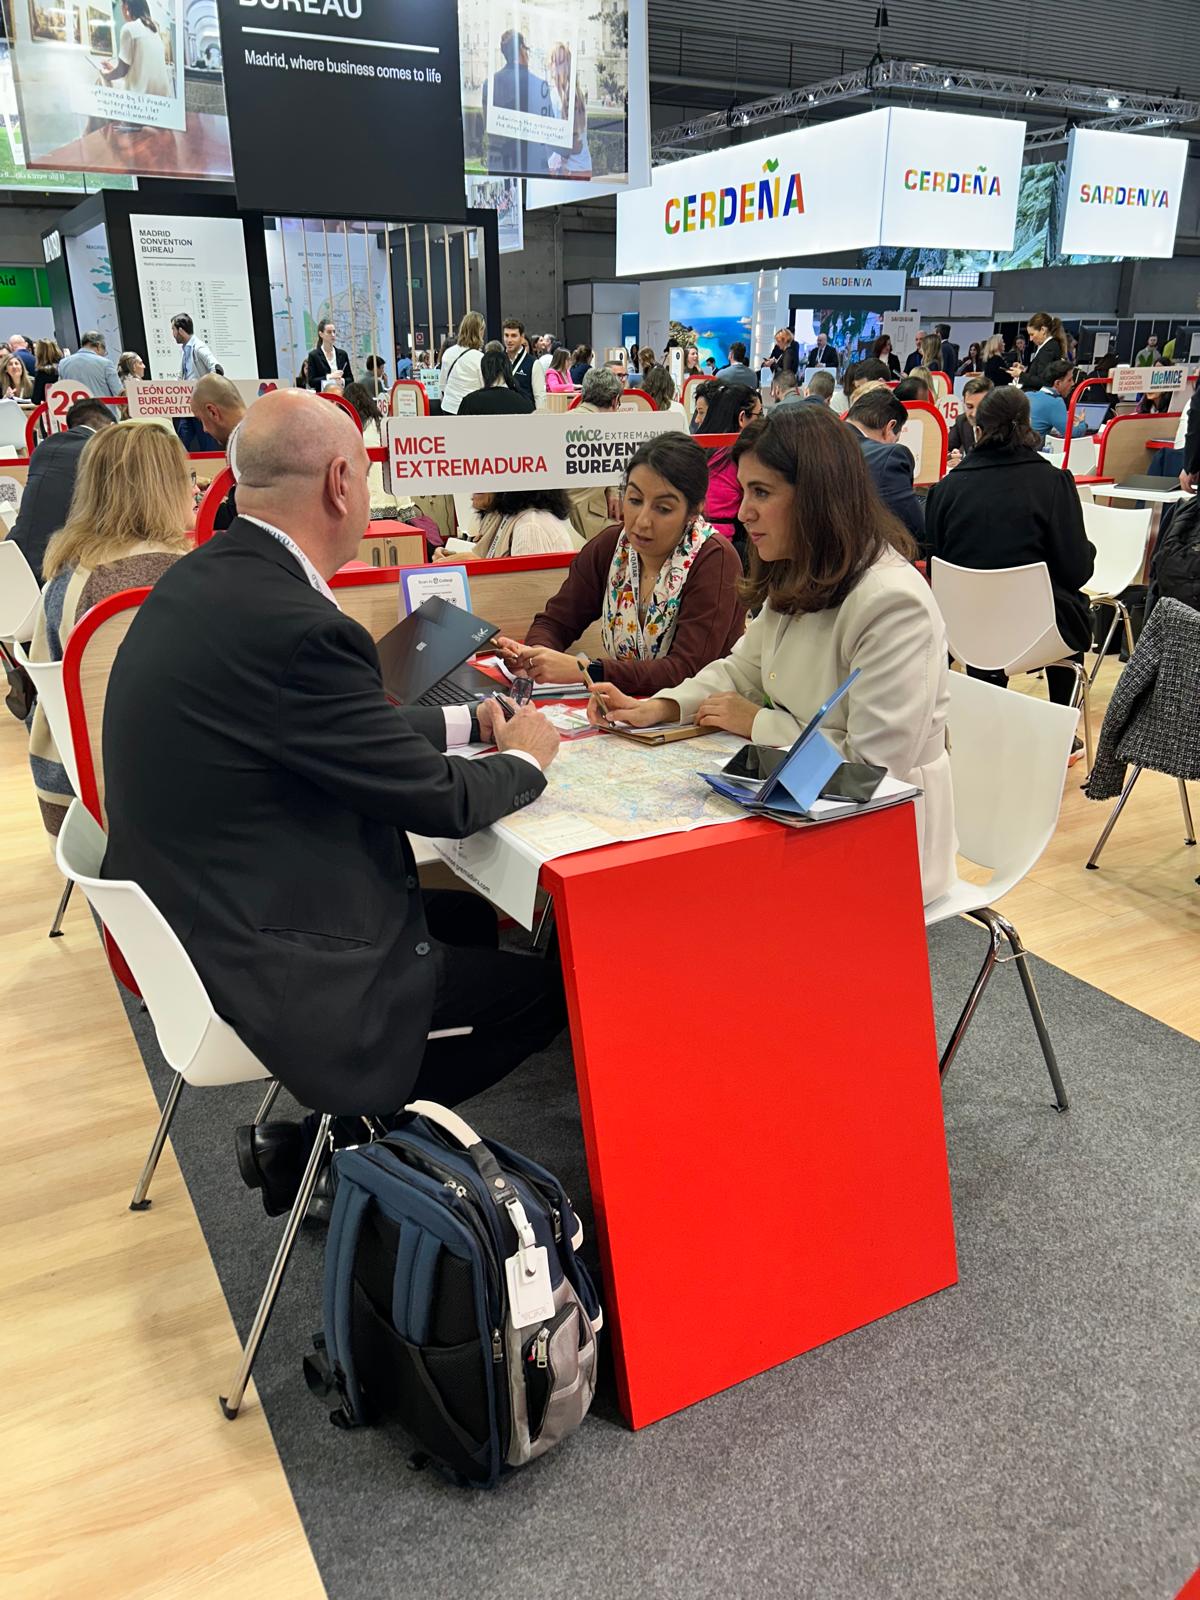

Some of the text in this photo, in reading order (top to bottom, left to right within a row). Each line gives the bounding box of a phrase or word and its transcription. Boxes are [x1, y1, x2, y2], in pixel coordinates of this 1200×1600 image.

[239, 0, 362, 19] REAU
[244, 49, 442, 83] Madrid, where business comes to life
[904, 165, 1001, 196] CERDEÑA
[665, 158, 805, 235] CERDEÑA
[1079, 183, 1169, 209] SARDENYA
[139, 229, 171, 237] MADRID
[140, 237, 193, 246] CONVENTION
[141, 246, 174, 254] BUREAU
[0, 274, 16, 287] Aid
[822, 276, 873, 287] SARDENYA
[1151, 370, 1183, 385] IdeMICE
[136, 384, 194, 395] LEÓN CONV
[138, 396, 178, 405] BUREAU
[140, 405, 191, 415] CONVENTI
[943, 402, 959, 419] 15
[566, 425, 669, 442] mice EXTREMADU
[394, 436, 446, 455] MICE
[395, 455, 548, 479] EXTREMADURA
[630, 556, 638, 578] QATAR
